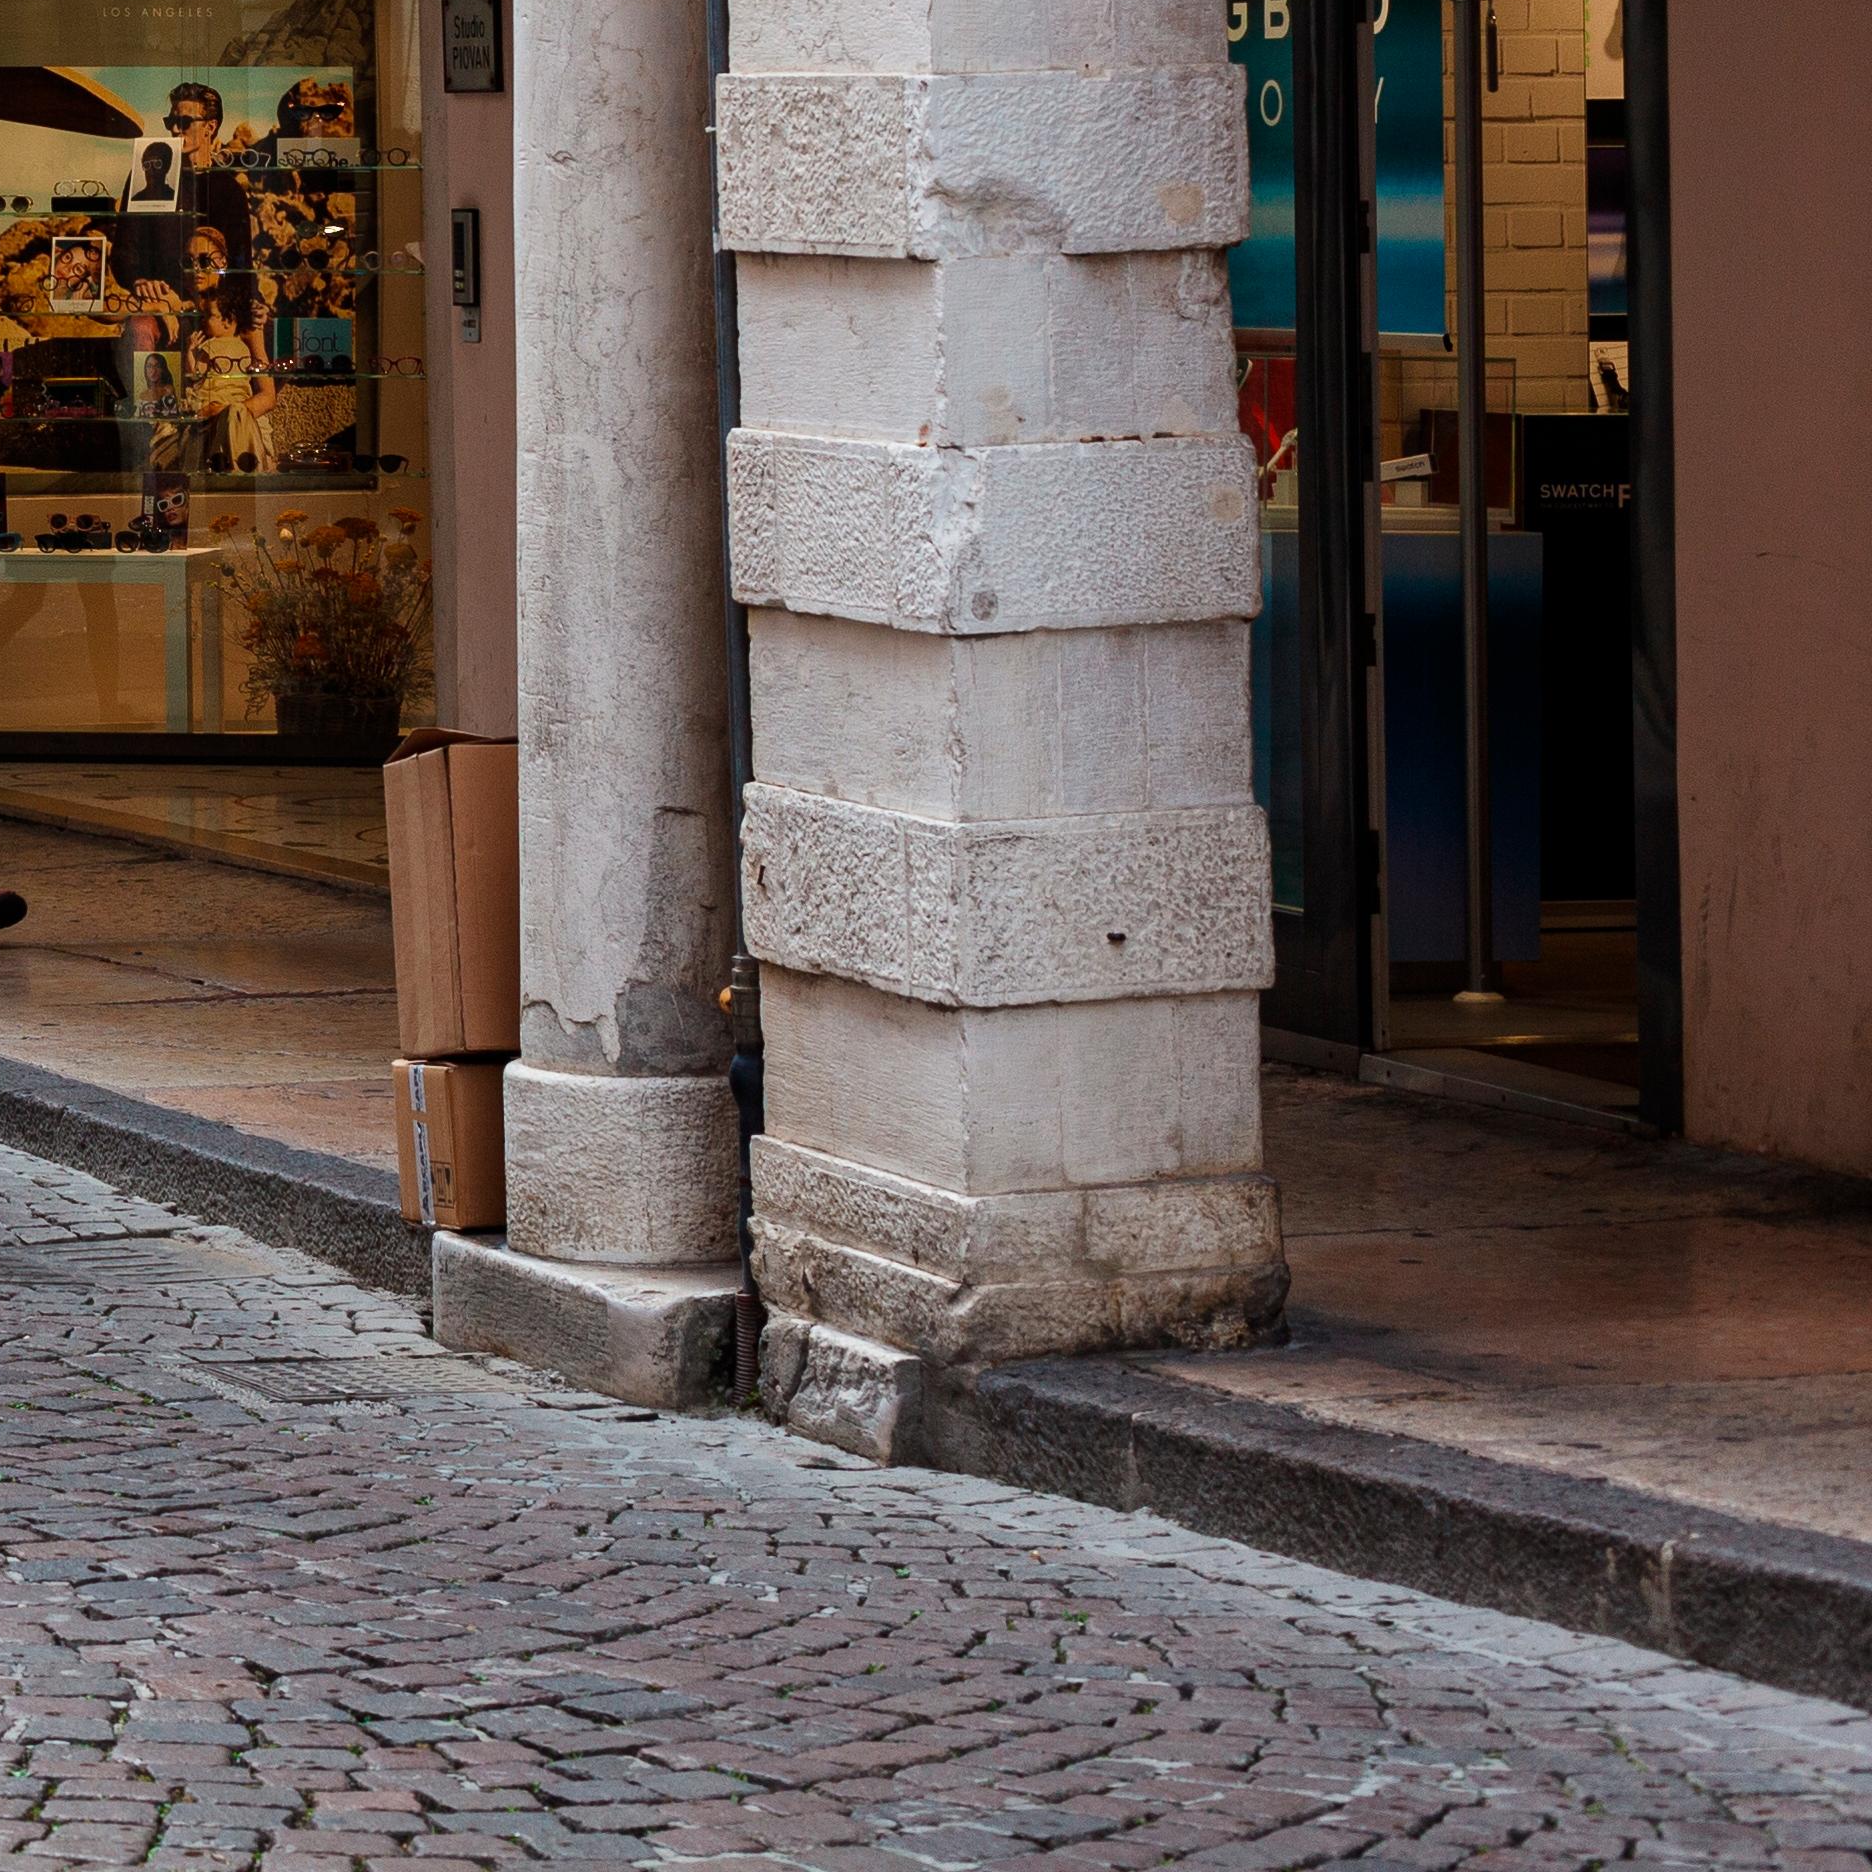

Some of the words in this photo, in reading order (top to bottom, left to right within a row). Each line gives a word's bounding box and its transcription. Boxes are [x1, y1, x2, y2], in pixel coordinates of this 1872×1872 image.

[103, 7, 131, 17] LOS
[141, 7, 213, 17] ANGELES
[454, 15, 485, 39] Studio
[1540, 483, 1614, 498] SWATCH
